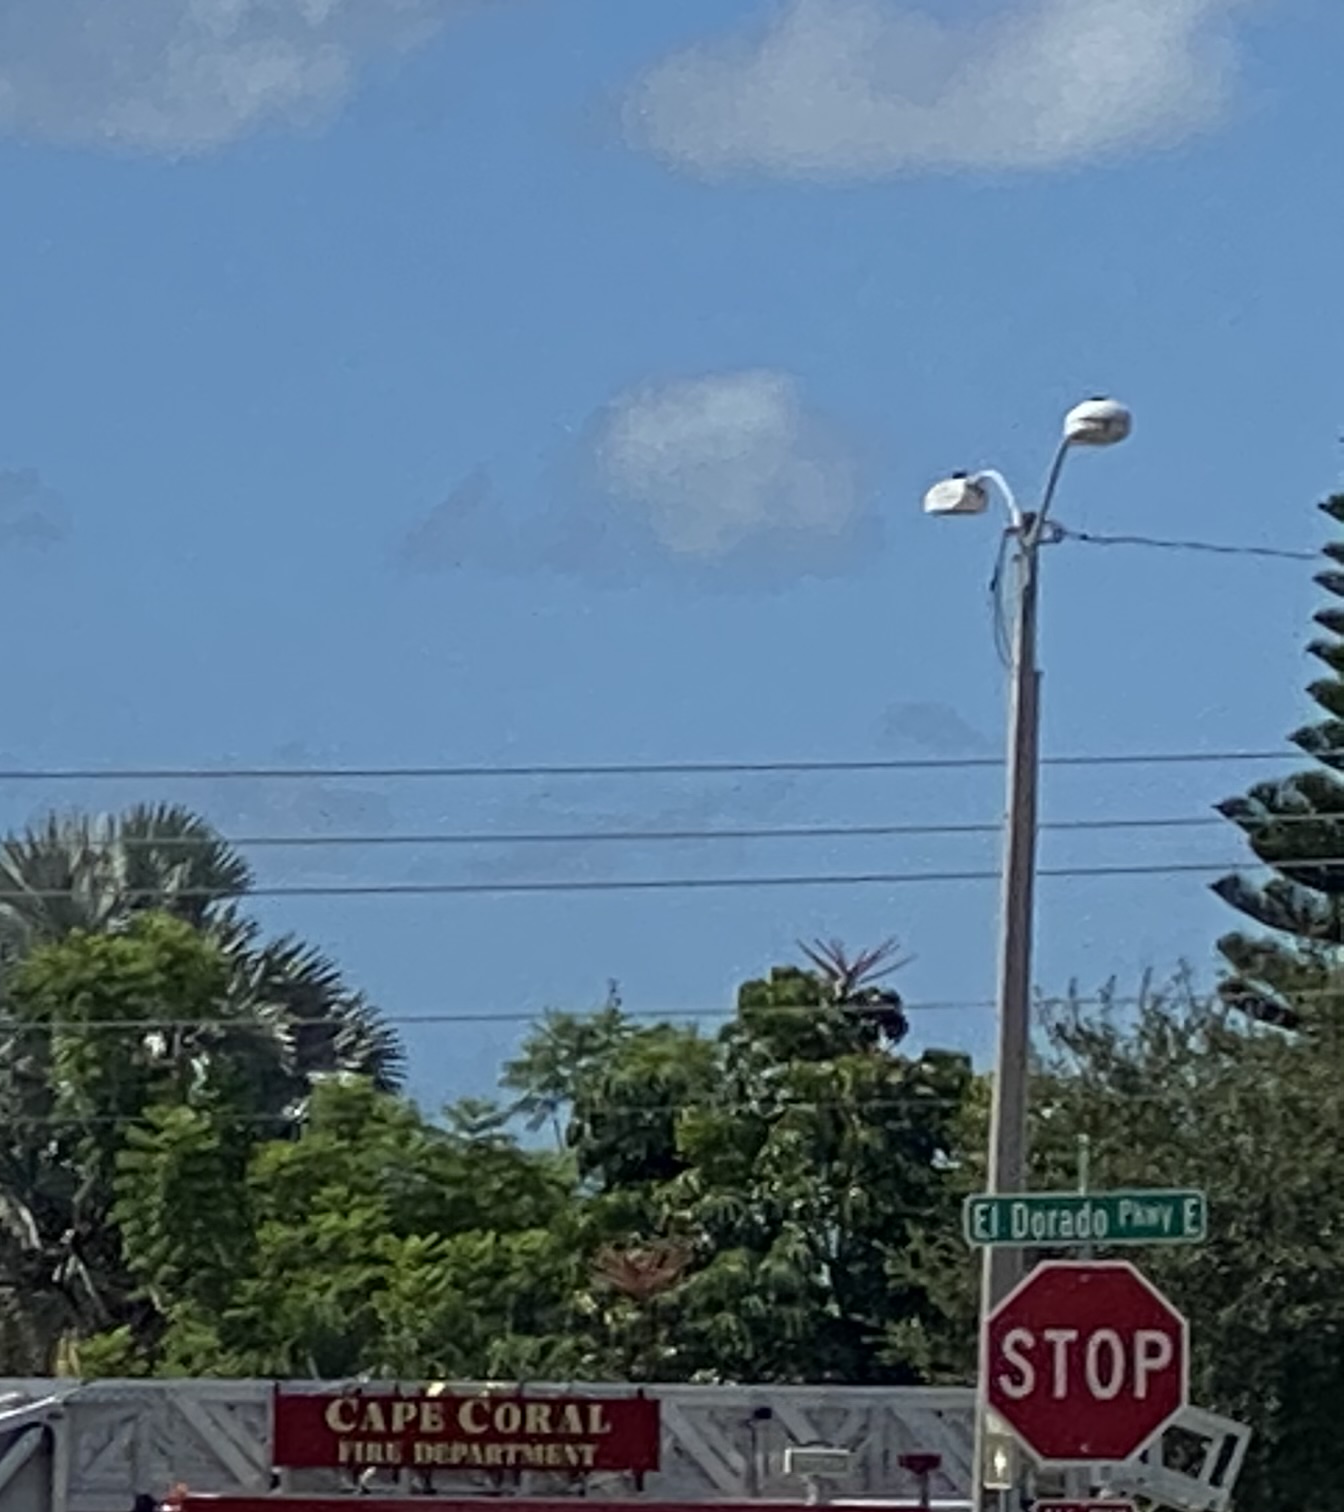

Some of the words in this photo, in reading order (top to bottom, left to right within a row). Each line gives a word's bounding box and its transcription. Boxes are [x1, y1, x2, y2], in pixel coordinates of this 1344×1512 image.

[973, 1203, 998, 1239] El
[1011, 1200, 1109, 1239] Dorado
[1119, 1200, 1173, 1233] Pkwy
[1183, 1198, 1200, 1234] E
[998, 1328, 1173, 1400] STOP
[324, 1396, 446, 1433] CAPE
[457, 1396, 611, 1435] CORAL
[338, 1440, 402, 1465] FIRE
[413, 1440, 599, 1467] DEPARTMENT
